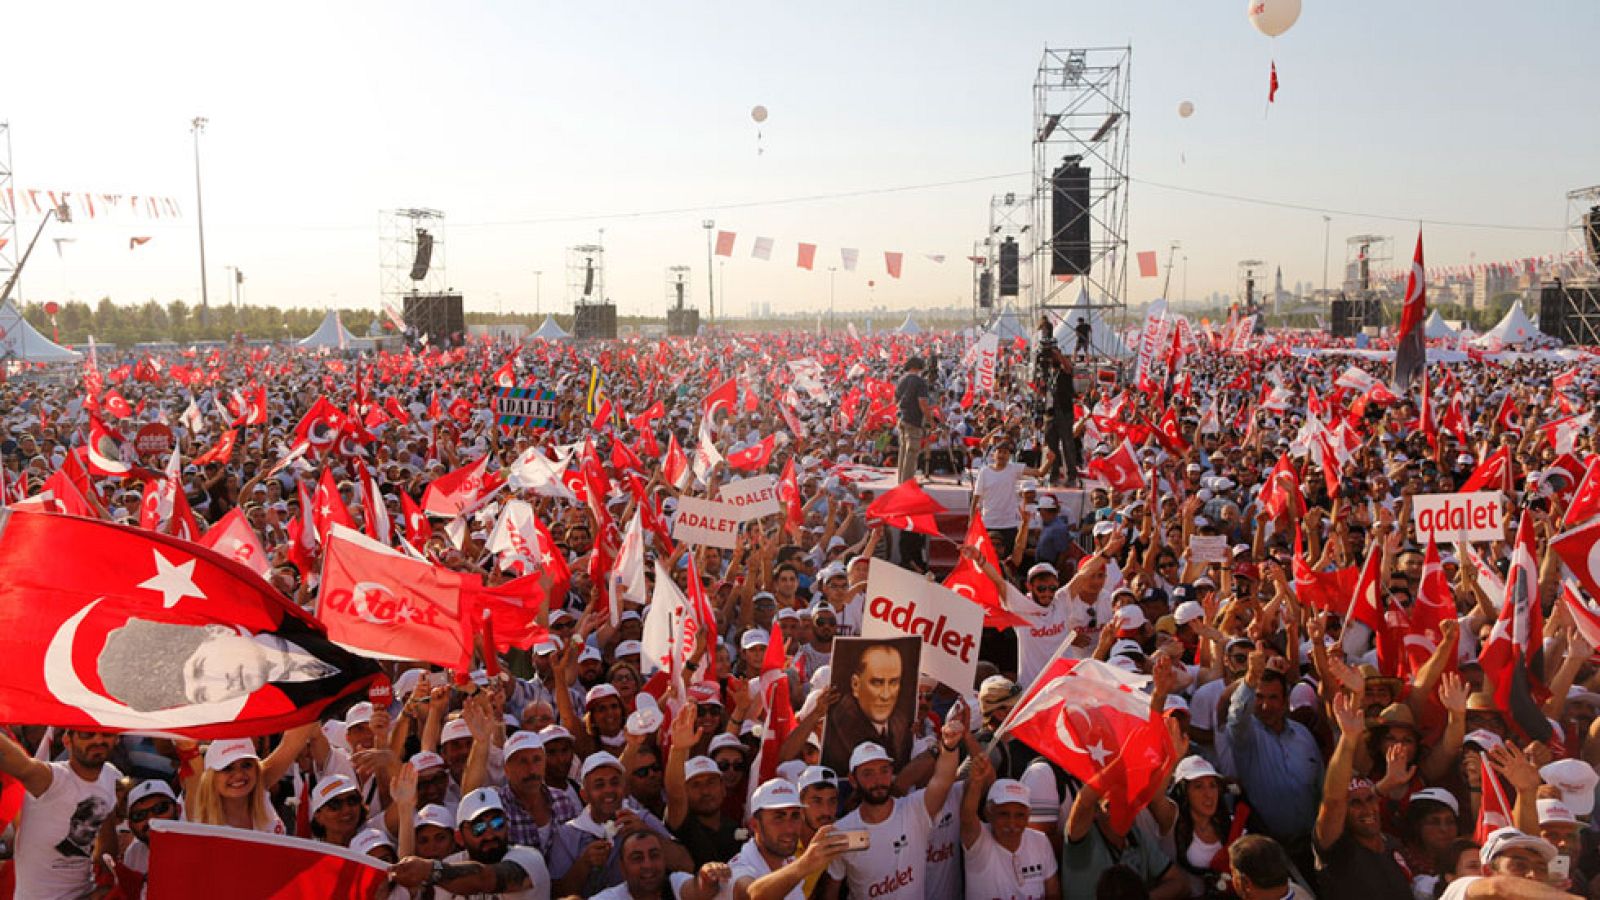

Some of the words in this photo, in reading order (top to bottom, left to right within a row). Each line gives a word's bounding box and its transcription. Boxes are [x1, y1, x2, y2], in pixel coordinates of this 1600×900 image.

[495, 398, 553, 416] ADALET
[677, 512, 737, 533] ADALET
[1418, 499, 1498, 532] adalet
[870, 595, 976, 664] adalet
[868, 865, 914, 899] adalet
